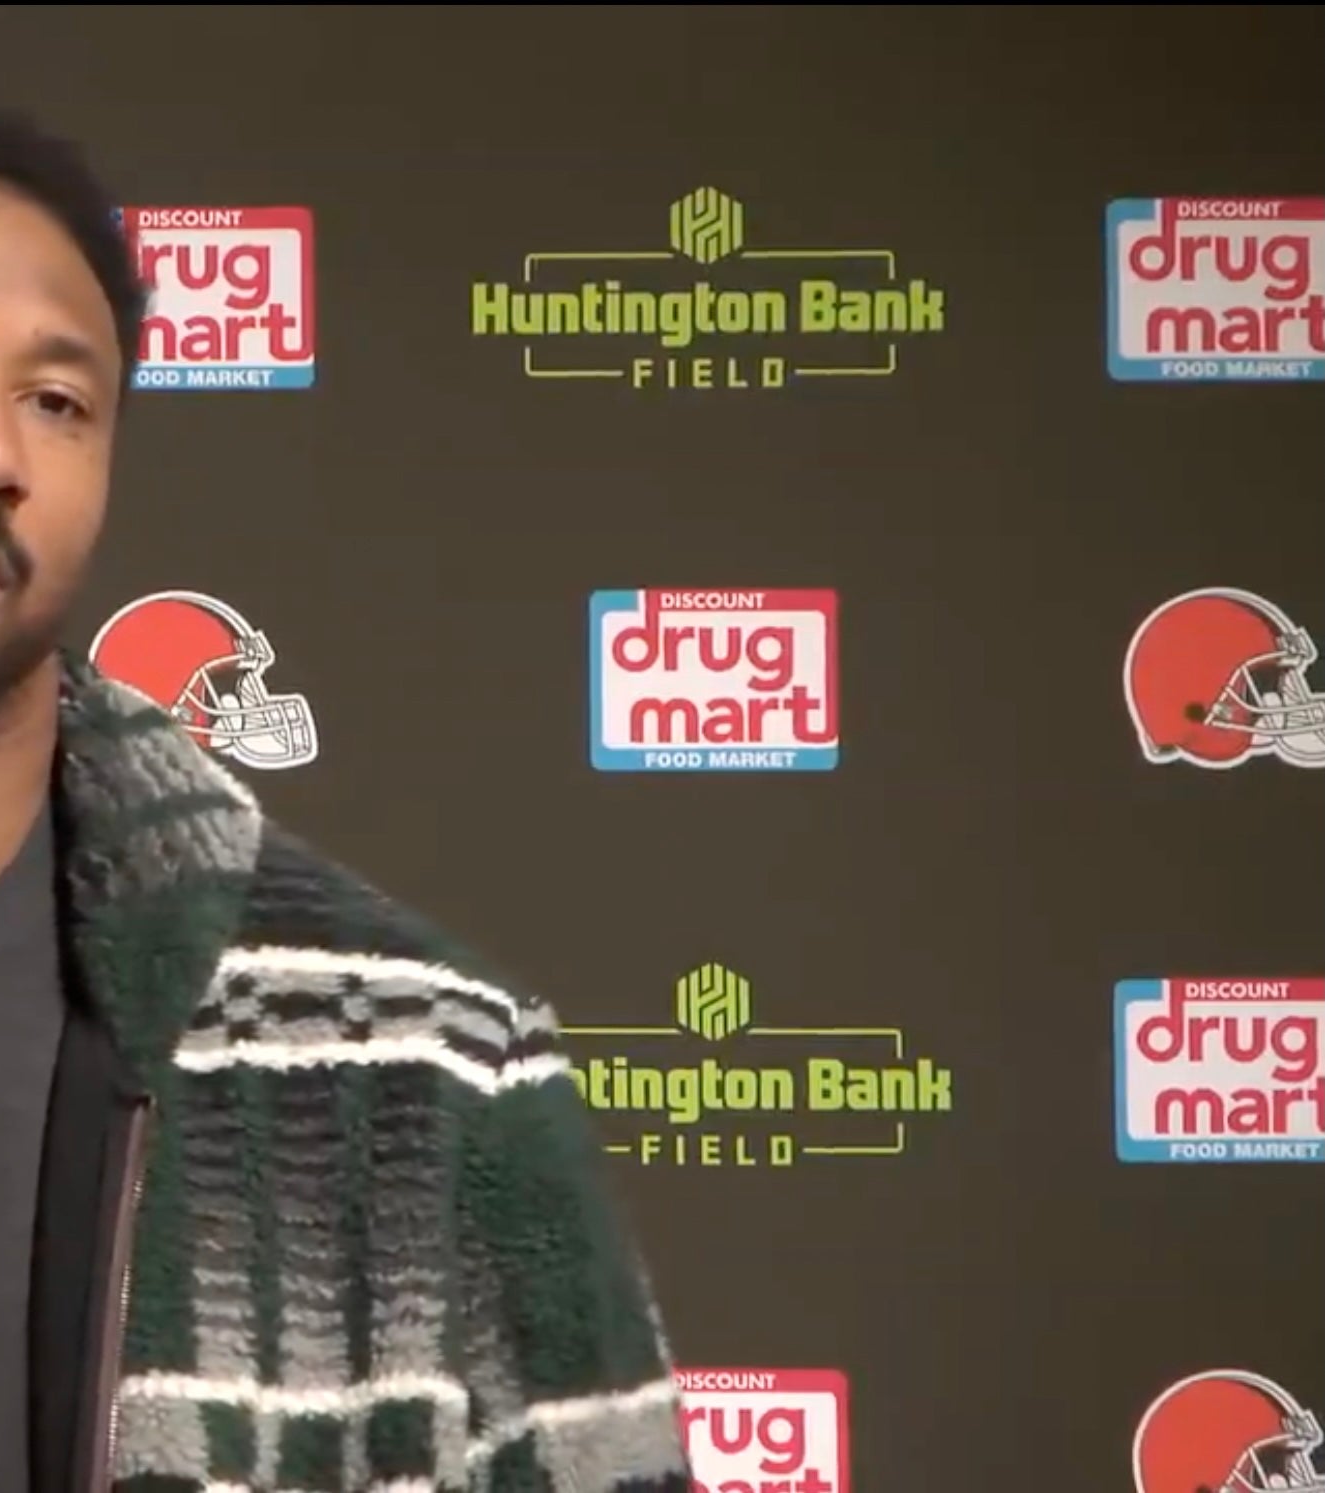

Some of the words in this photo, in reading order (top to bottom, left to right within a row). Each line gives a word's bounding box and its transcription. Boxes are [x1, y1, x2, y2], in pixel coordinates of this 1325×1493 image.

[138, 210, 244, 226] DISCOUNT
[1177, 200, 1282, 218] DISCOUNT
[1129, 199, 1310, 302] drug
[130, 232, 271, 310] rug
[472, 280, 787, 347] Huntington
[800, 279, 944, 333] Bank
[137, 370, 180, 386] OOD
[187, 370, 274, 386] MARKET
[632, 357, 785, 388] FIELD
[1161, 361, 1219, 377] FOOD
[1226, 361, 1313, 377] MARKET
[660, 592, 765, 609] DISCOUNT
[612, 589, 794, 692] drug
[630, 686, 838, 744] mart
[645, 752, 702, 768] FOOD
[709, 752, 796, 768] MARKET
[1185, 982, 1290, 999] DISCOUNT
[1137, 979, 1317, 1083] drug
[808, 1058, 952, 1111] Bank
[641, 1135, 793, 1166] FIELD
[1169, 1142, 1226, 1159] FOOD
[1233, 1142, 1321, 1159] MARKET
[680, 1406, 805, 1475] rug
